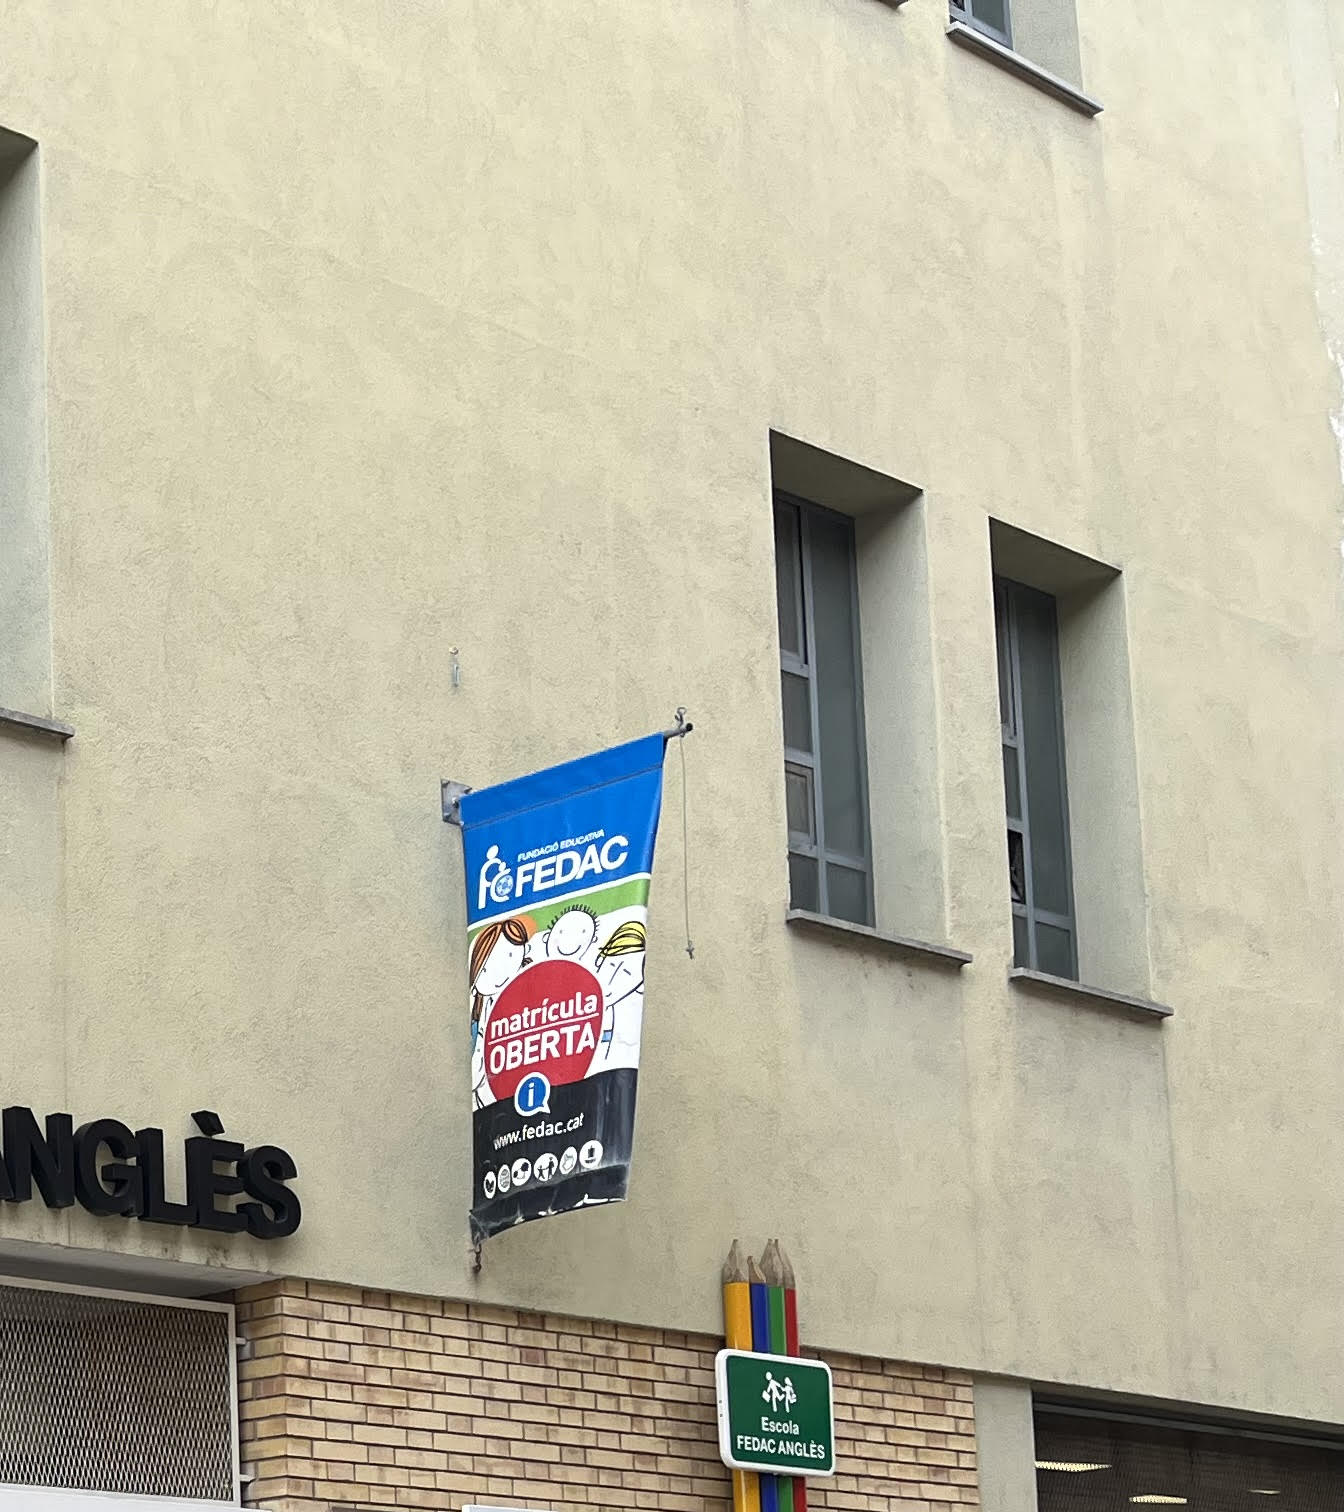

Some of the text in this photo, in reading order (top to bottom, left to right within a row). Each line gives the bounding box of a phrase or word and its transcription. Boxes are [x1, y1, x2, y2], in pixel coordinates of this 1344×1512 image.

[517, 828, 605, 863] FUNDACIÓ EDUCATIVA
[514, 835, 629, 898] FEDAC
[490, 991, 598, 1039] matrícula
[489, 1021, 596, 1075] OBERTA
[493, 1112, 585, 1151] www.fedac.cat
[760, 1416, 800, 1435] Escola
[736, 1435, 826, 1460] FEDAC ANGLÈS
